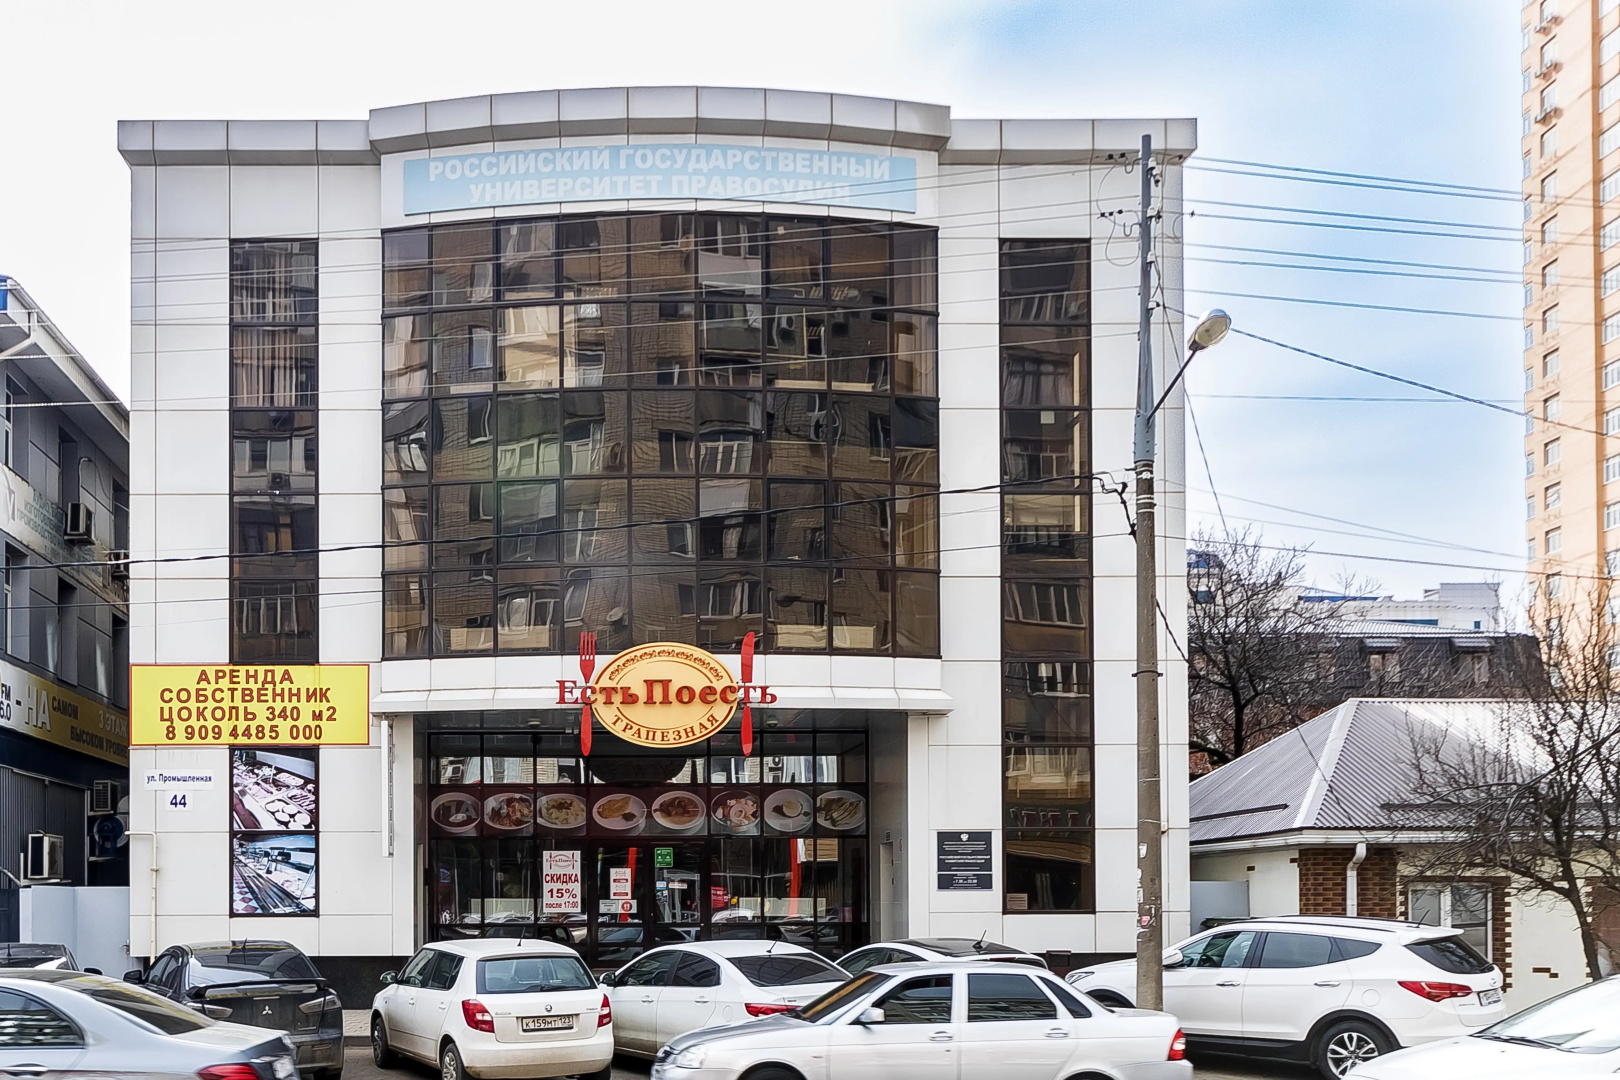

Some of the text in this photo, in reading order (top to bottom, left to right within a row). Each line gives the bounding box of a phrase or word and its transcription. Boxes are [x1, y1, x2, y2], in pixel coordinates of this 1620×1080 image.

[429, 146, 890, 182] РОССИЙСКИЙ ГОСУДАРСТВЕННЫЙ
[468, 174, 851, 203] УНИВЕРСИТЕТ ПРАВОСУДИЯ
[196, 669, 294, 687] АРЕНДА
[159, 687, 331, 704] СОБСТВЕННИК
[159, 706, 337, 725] ЦОКОЛЬ 340 м2
[165, 725, 323, 740] 8 909 4485 000
[612, 713, 720, 743] ТРАПЕЗНАЯ
[146, 773, 212, 784] ул. Промышленная
[169, 794, 187, 808] 44
[544, 873, 580, 885] СКИДКА
[547, 888, 578, 899] 15%
[564, 901, 579, 909] 17:00
[559, 1015, 572, 1024] 123
